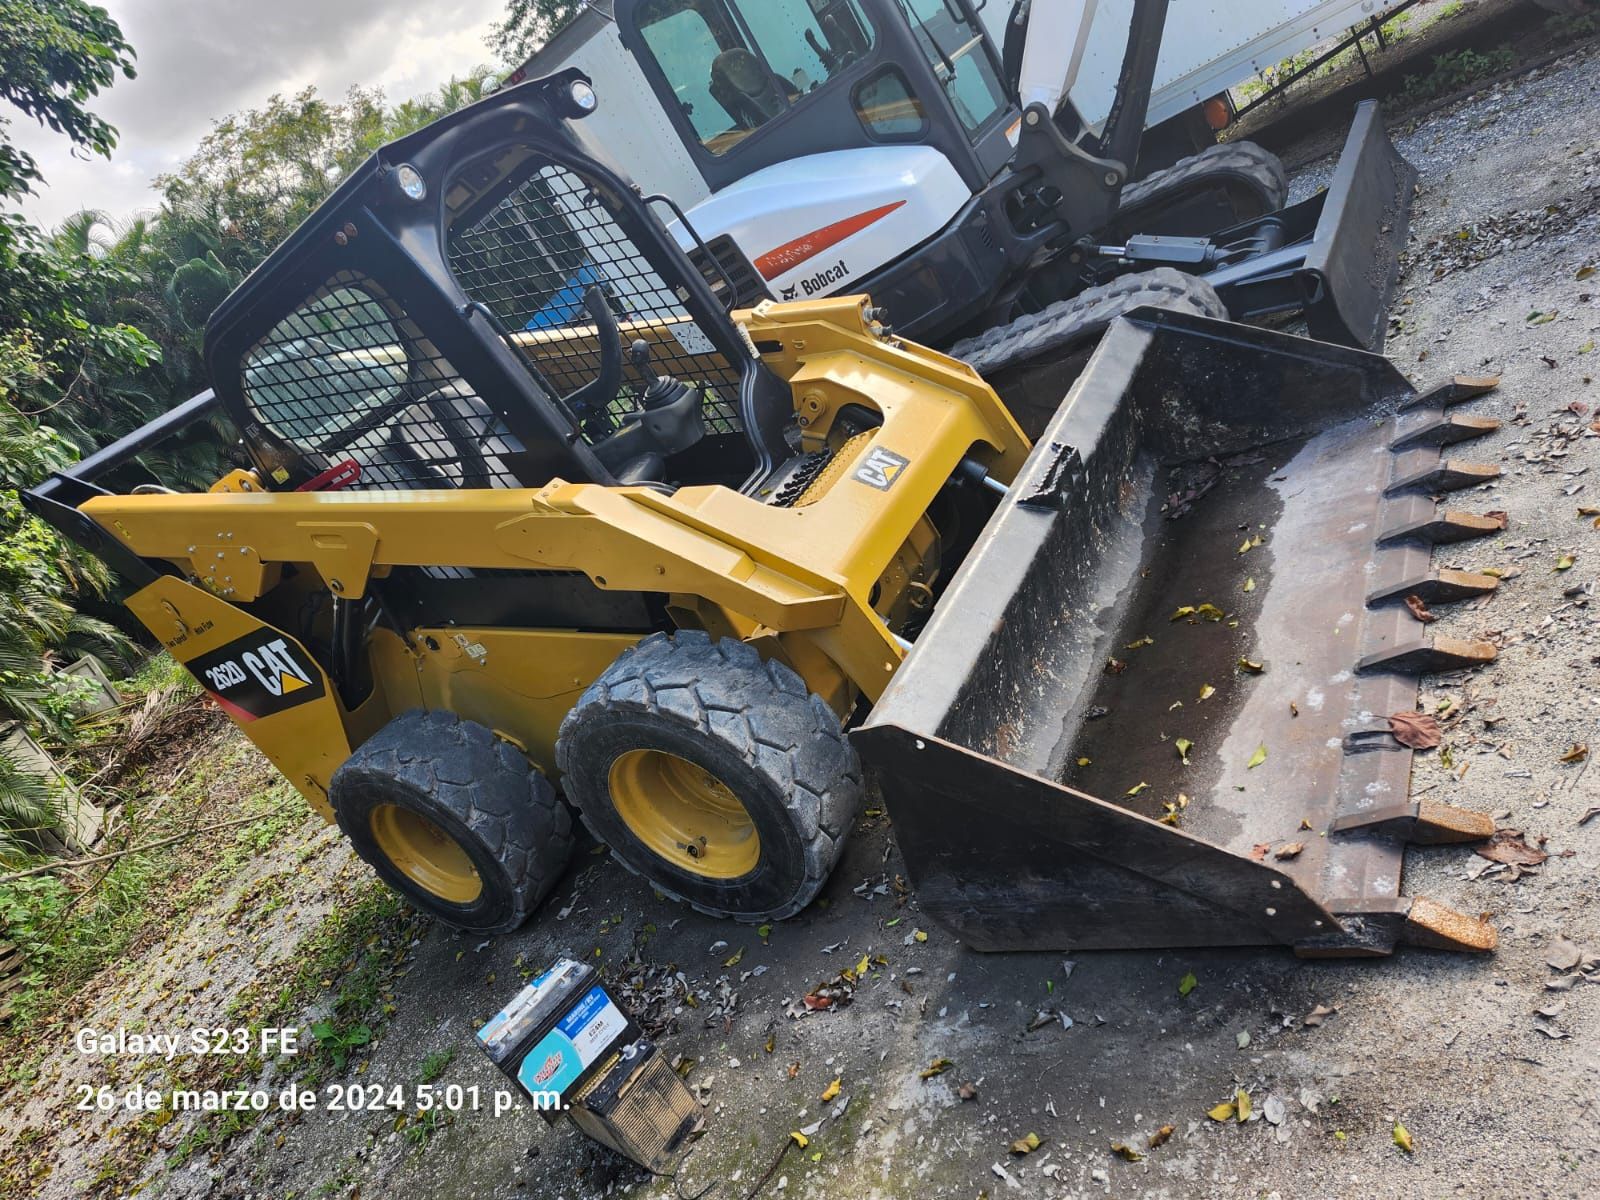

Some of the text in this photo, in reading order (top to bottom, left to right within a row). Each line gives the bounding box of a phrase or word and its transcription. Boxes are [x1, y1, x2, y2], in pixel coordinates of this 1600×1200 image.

[801, 259, 850, 297] Bobcat
[857, 450, 904, 487] CAT
[205, 638, 313, 696] 262D CAT
